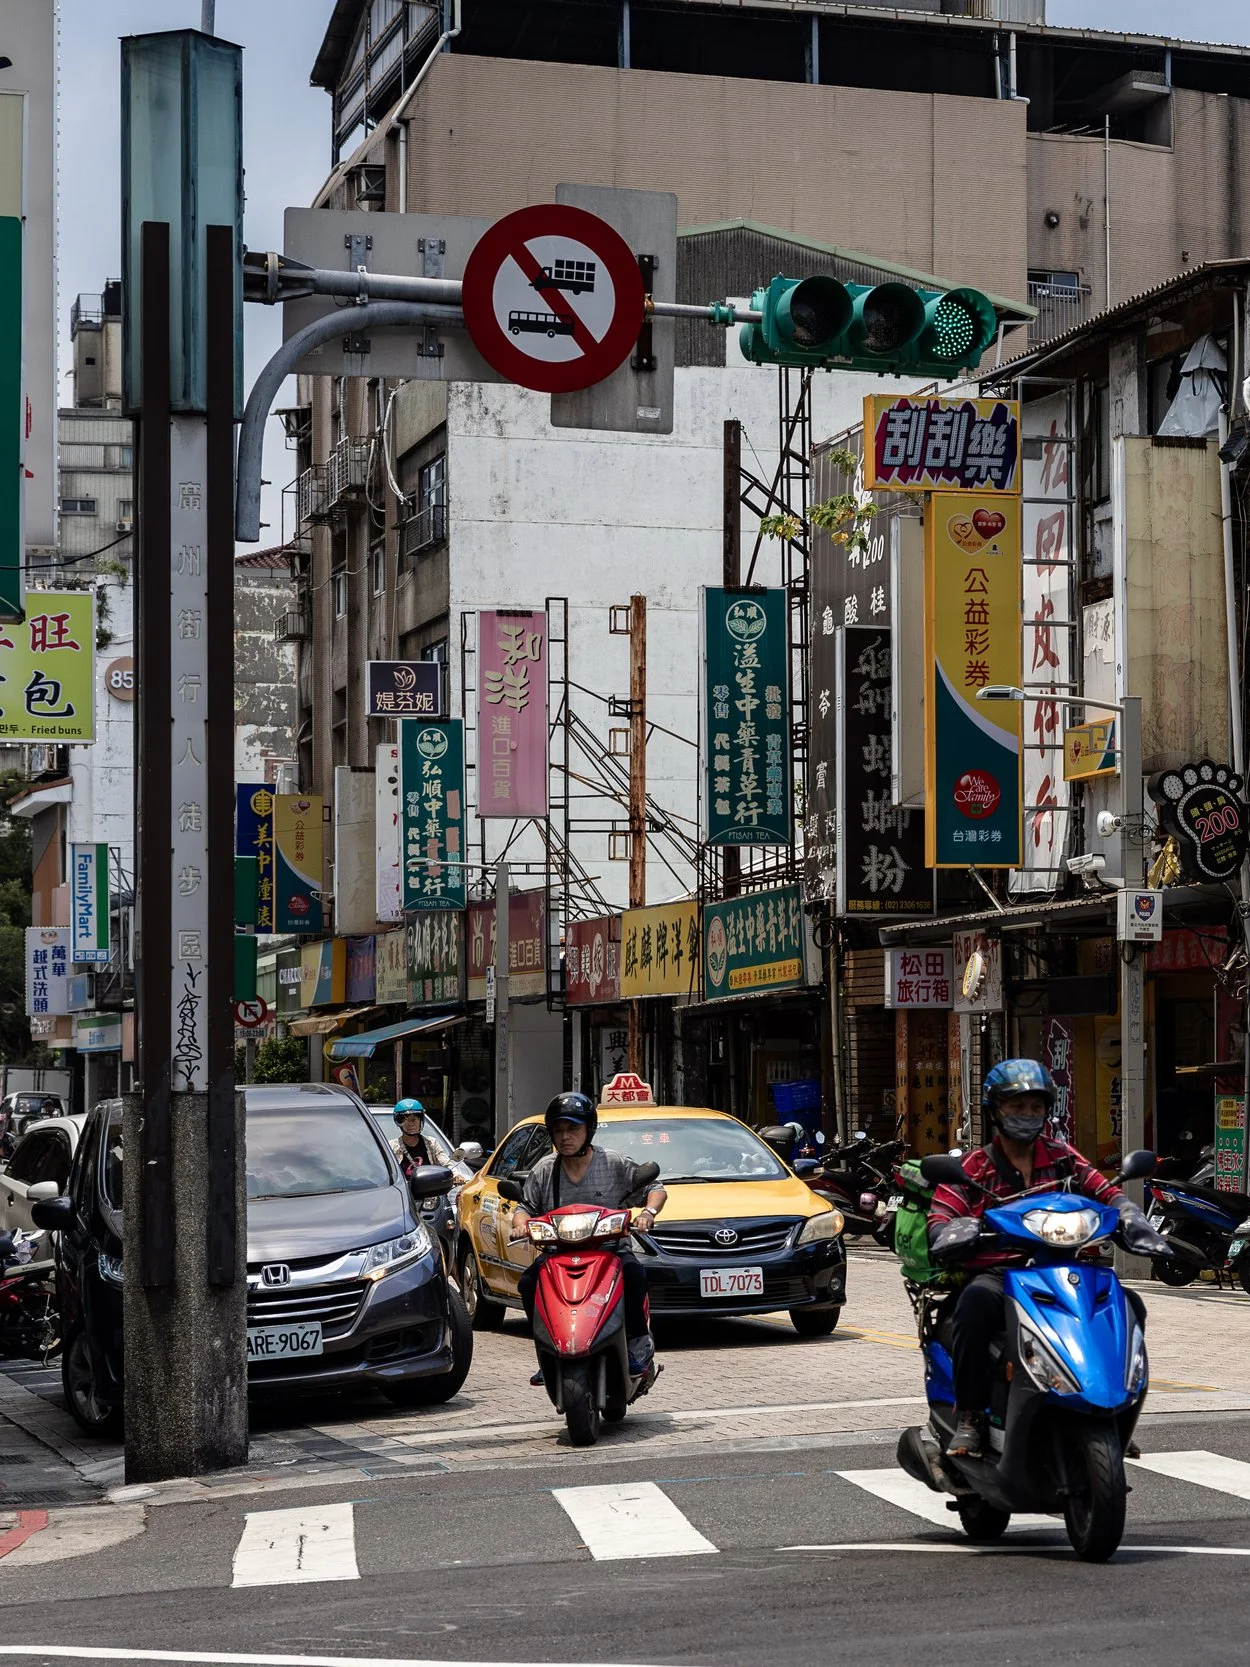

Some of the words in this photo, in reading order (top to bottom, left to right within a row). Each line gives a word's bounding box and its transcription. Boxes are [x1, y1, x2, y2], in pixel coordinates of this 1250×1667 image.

[884, 407, 1011, 481] 刮刮樂
[964, 567, 991, 687] 公益彩券
[713, 684, 730, 719] 零售
[765, 685, 782, 720] 批發
[31, 725, 56, 735] Fried
[58, 725, 82, 735] buns
[178, 481, 202, 961] 廣州街行人徒步區
[733, 643, 764, 825] 溢生中藥青草行
[491, 714, 512, 800] 進口百貨
[968, 776, 985, 786] We
[954, 789, 1001, 809] Family
[421, 760, 446, 896] 弘順中藥行
[756, 830, 771, 840] TEA
[952, 829, 1003, 842] 台灣彩券
[1195, 805, 1239, 843] 200
[77, 852, 93, 940] FamilyMart
[51, 945, 67, 977] 萬華
[509, 937, 542, 969] 進口百貨
[900, 951, 944, 977] 松田
[32, 948, 48, 1013] 越式洗頭
[896, 978, 949, 1004] 旅行箱
[607, 1090, 649, 1102] 大都會
[620, 1077, 636, 1088] M
[642, 1132, 670, 1144] 空車
[703, 1272, 762, 1296] TDL-7073
